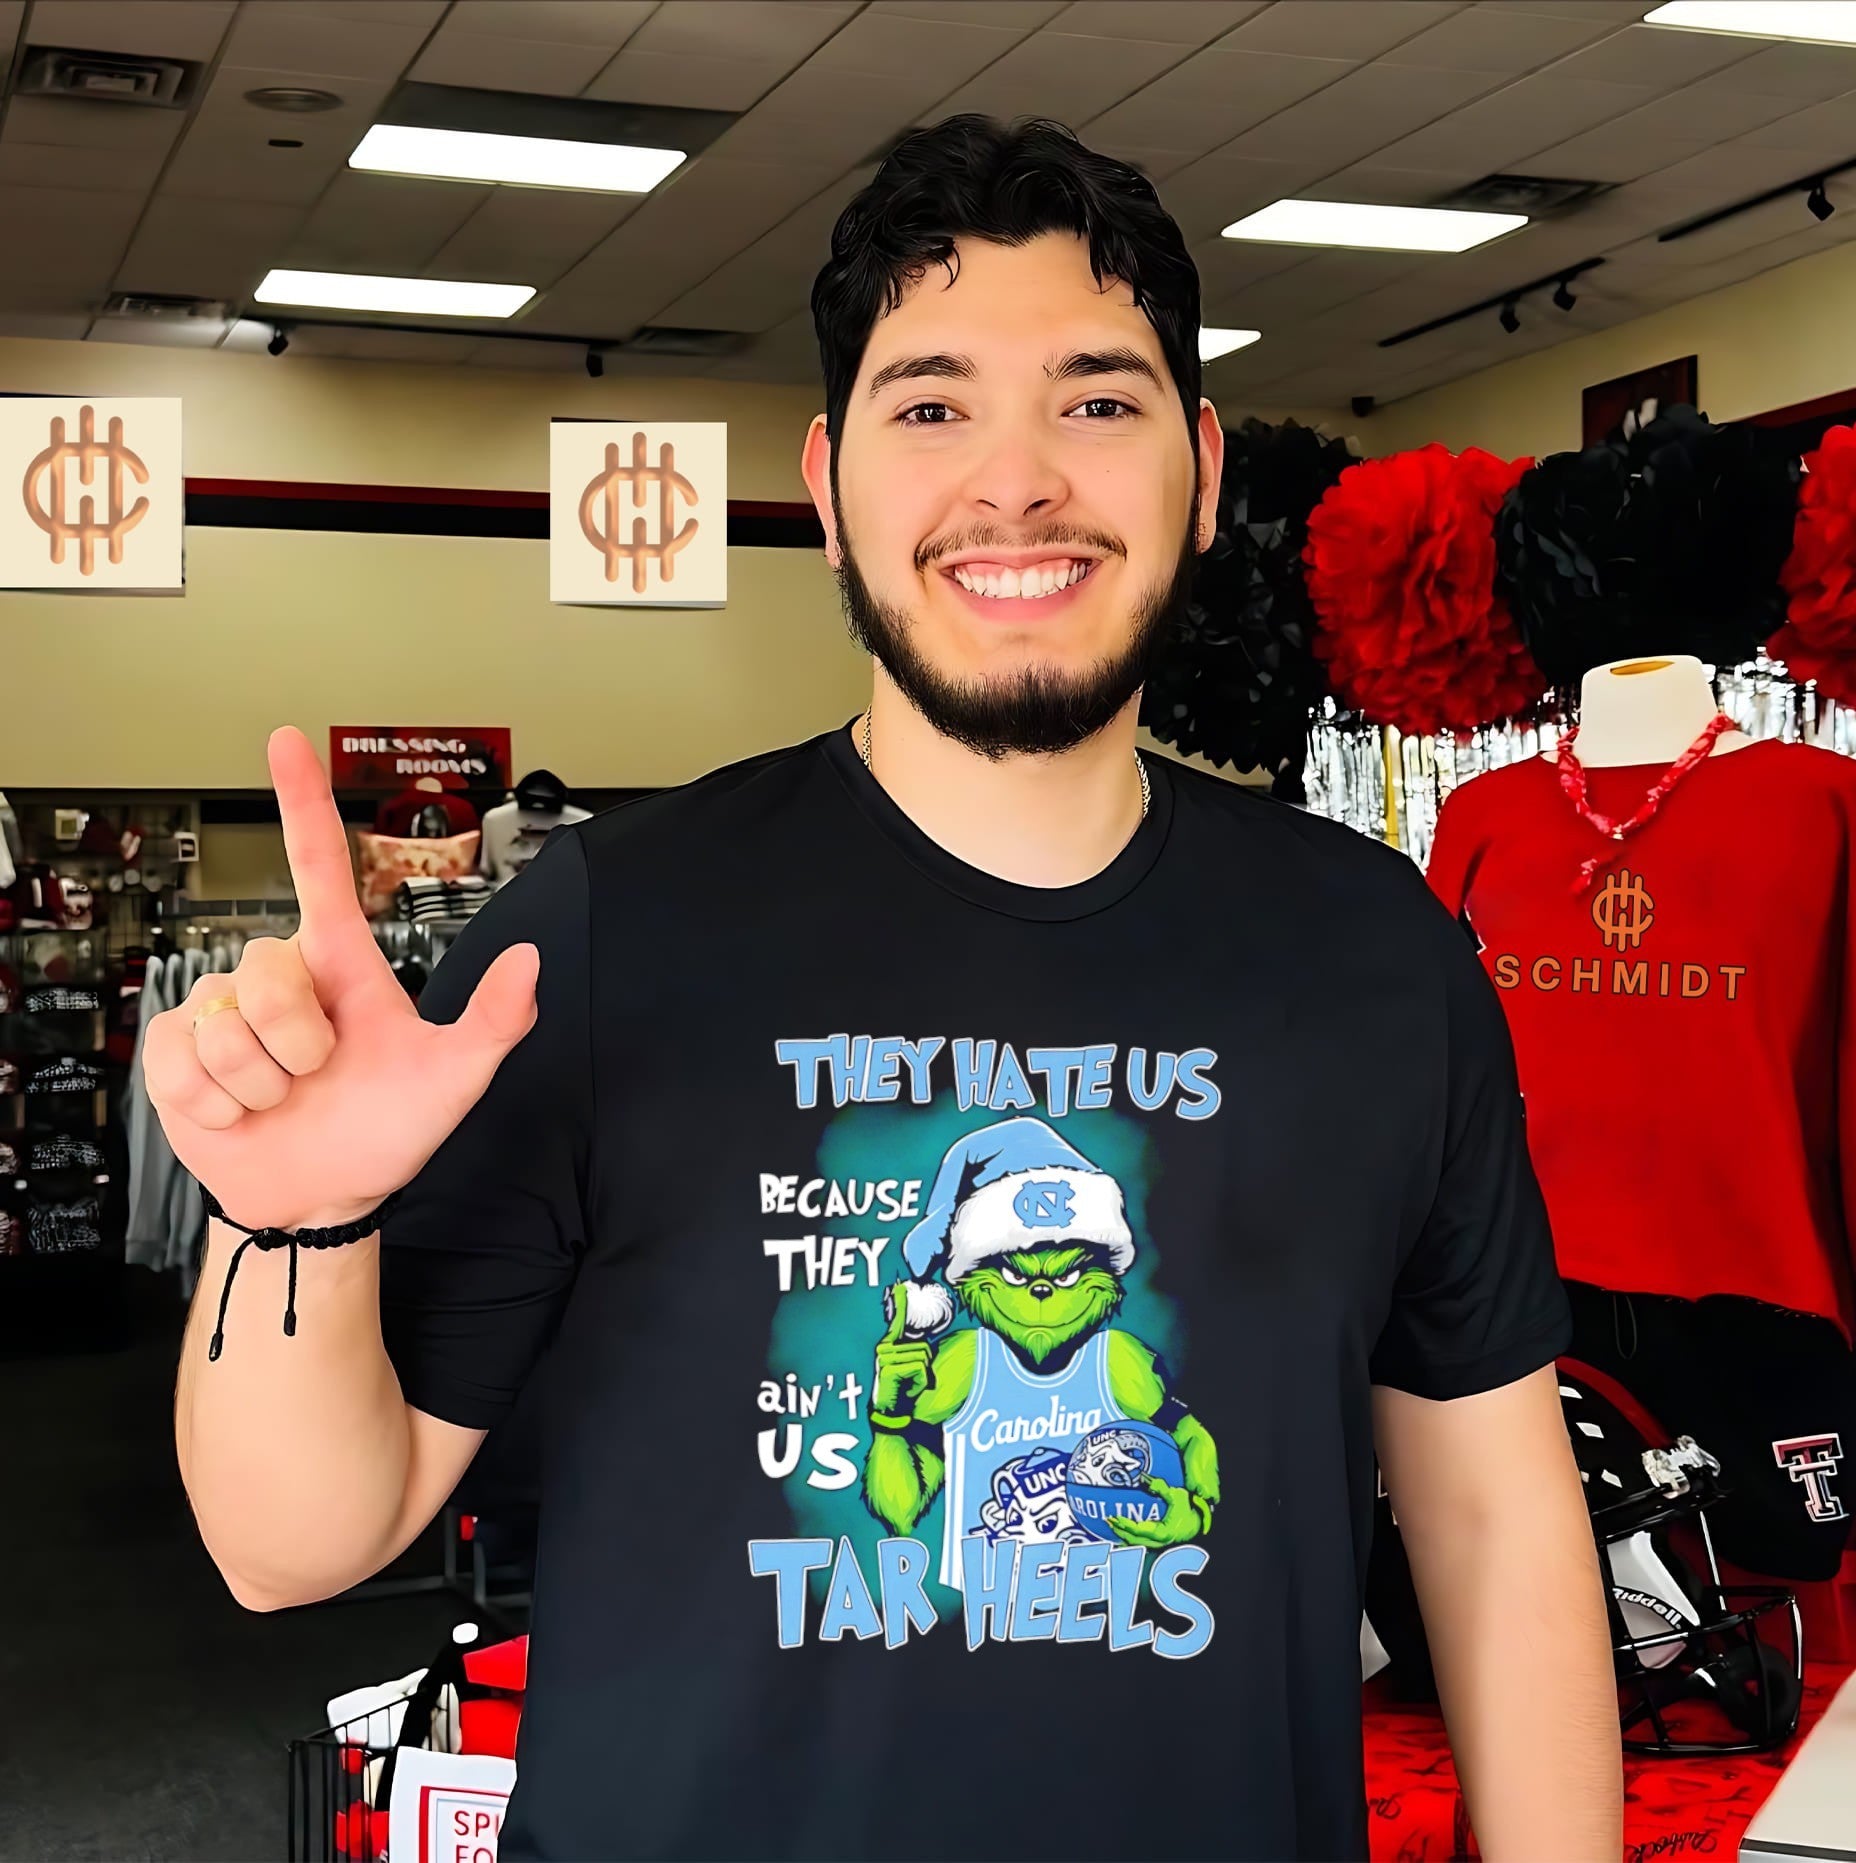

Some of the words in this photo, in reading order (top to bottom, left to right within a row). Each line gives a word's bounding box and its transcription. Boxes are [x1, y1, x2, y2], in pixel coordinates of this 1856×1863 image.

[342, 737, 467, 753] DRESSING
[396, 759, 487, 775] ROOMS
[1494, 954, 1746, 1000] SCHMIDT
[775, 1034, 945, 1109] THEY
[952, 1038, 1117, 1117] HATE
[1126, 1047, 1222, 1121] US
[759, 1173, 922, 1221] BECAUSE
[763, 1235, 890, 1291] THEY
[970, 1395, 1102, 1452] Carolina
[1092, 1430, 1117, 1445] UNC
[757, 1423, 860, 1491] US
[1025, 1464, 1067, 1495] UNC
[747, 1535, 939, 1650] TAR
[961, 1535, 1215, 1660] HEELS
[1612, 1587, 1682, 1626] Riddell
